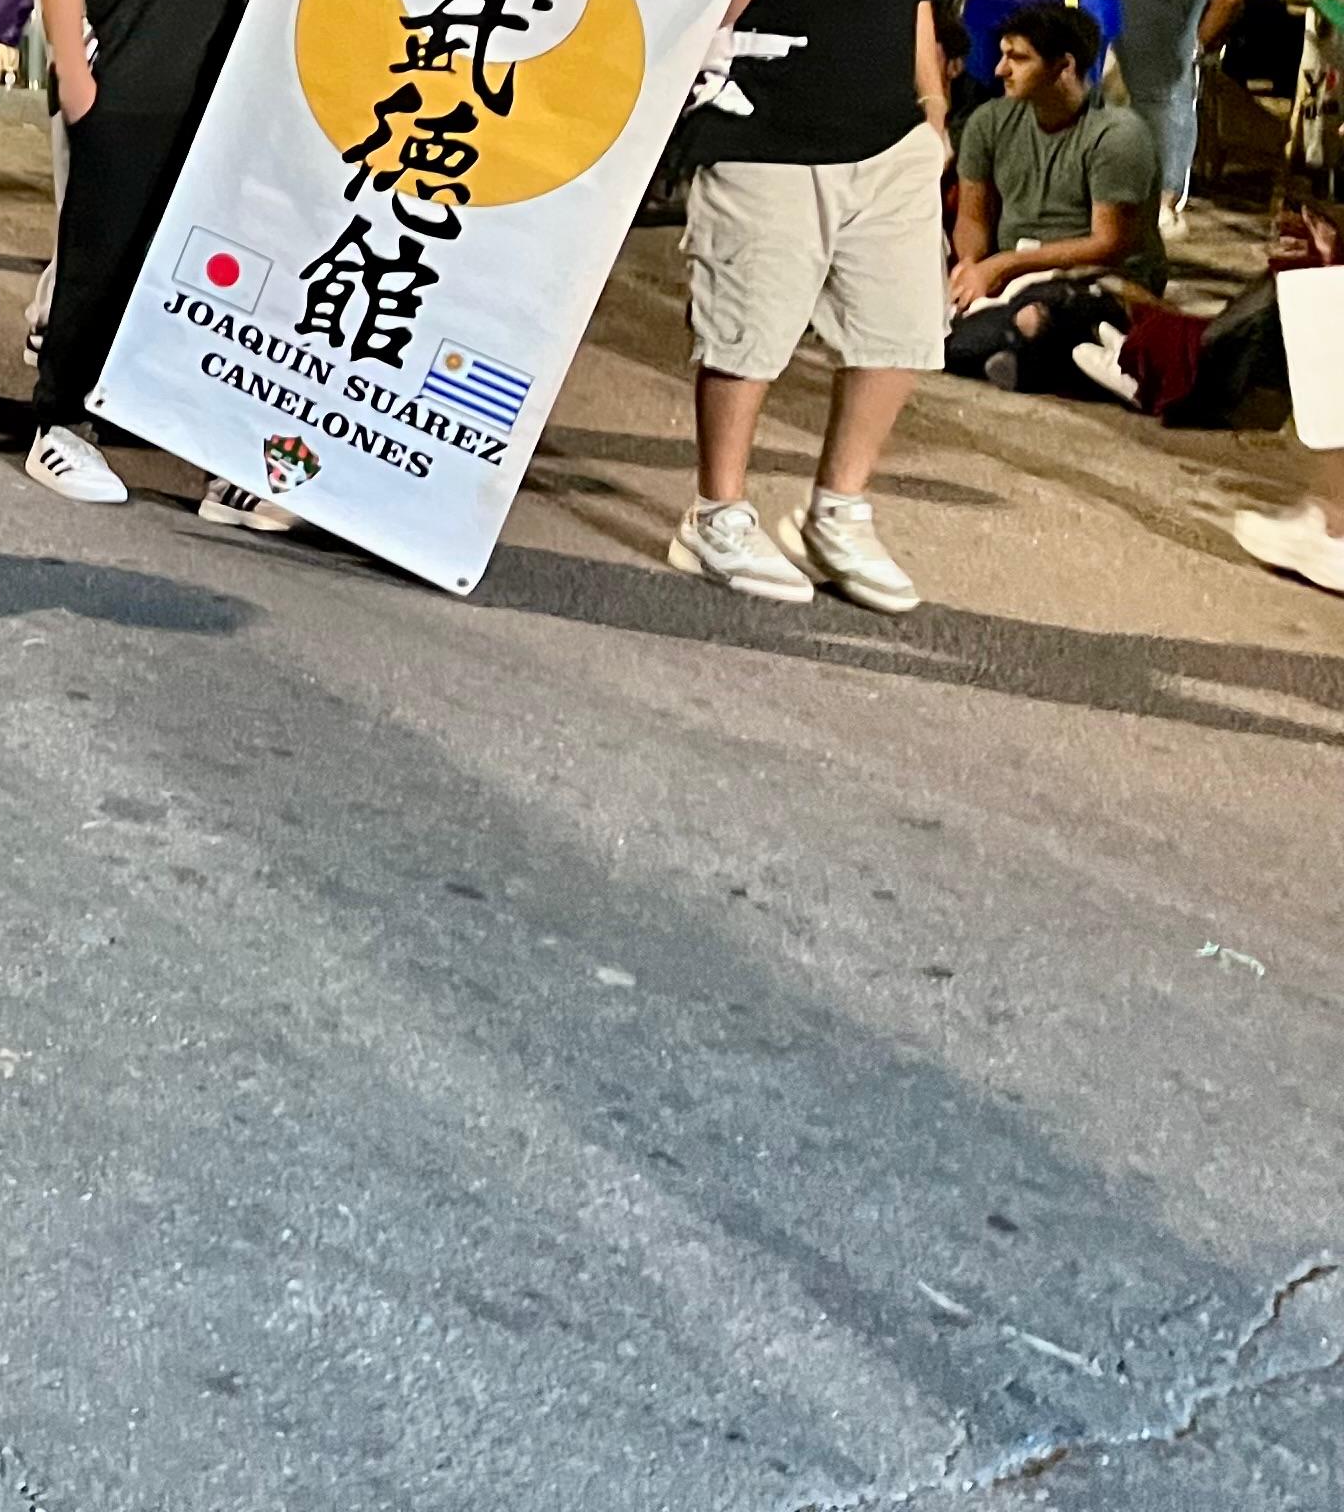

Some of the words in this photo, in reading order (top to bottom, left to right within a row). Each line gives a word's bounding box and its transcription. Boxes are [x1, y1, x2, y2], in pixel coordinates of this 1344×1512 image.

[163, 292, 336, 386] JOAQUÍN
[343, 375, 509, 467] SUÁREZ
[200, 352, 434, 478] CANELONES
